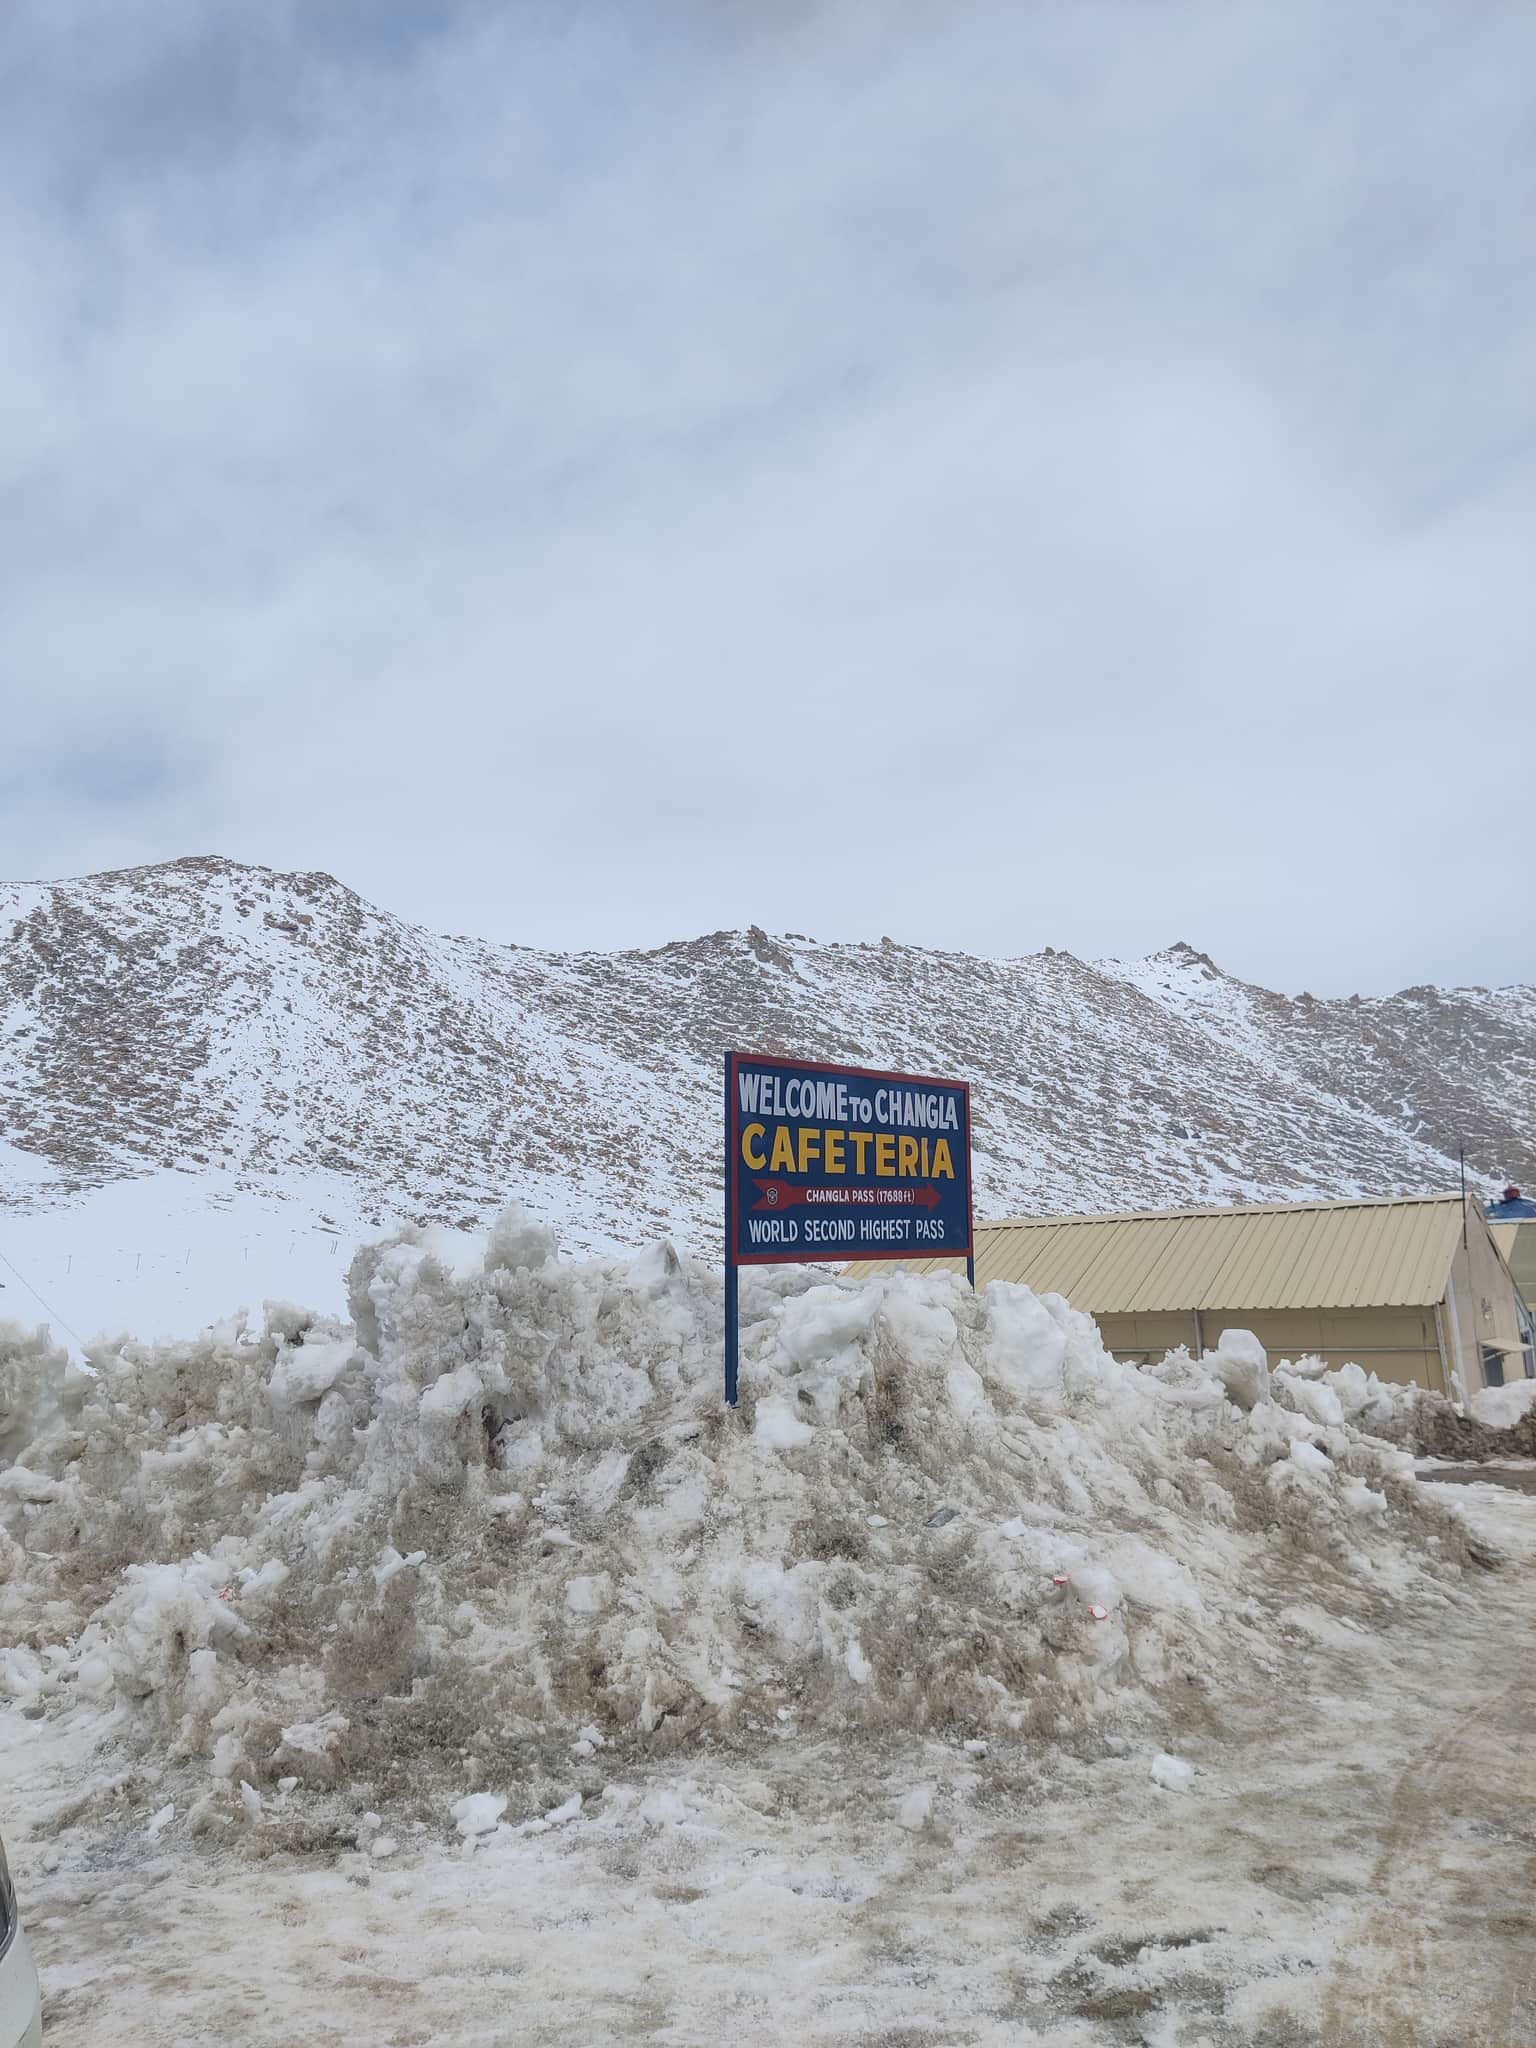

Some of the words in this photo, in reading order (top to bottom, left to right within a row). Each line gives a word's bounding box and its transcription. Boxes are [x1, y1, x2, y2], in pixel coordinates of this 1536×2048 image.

[738, 1072, 848, 1121] WELCOME
[848, 1096, 873, 1123] TO
[875, 1089, 959, 1130] CHANGLA
[741, 1122, 956, 1179] CAFETERIA
[806, 1189, 850, 1203] CHANGLA
[852, 1189, 874, 1203] PASS
[748, 1219, 798, 1243] WORLD
[804, 1219, 855, 1242] SECOND
[860, 1219, 912, 1241] HIGHEST
[915, 1219, 945, 1240] PASS
